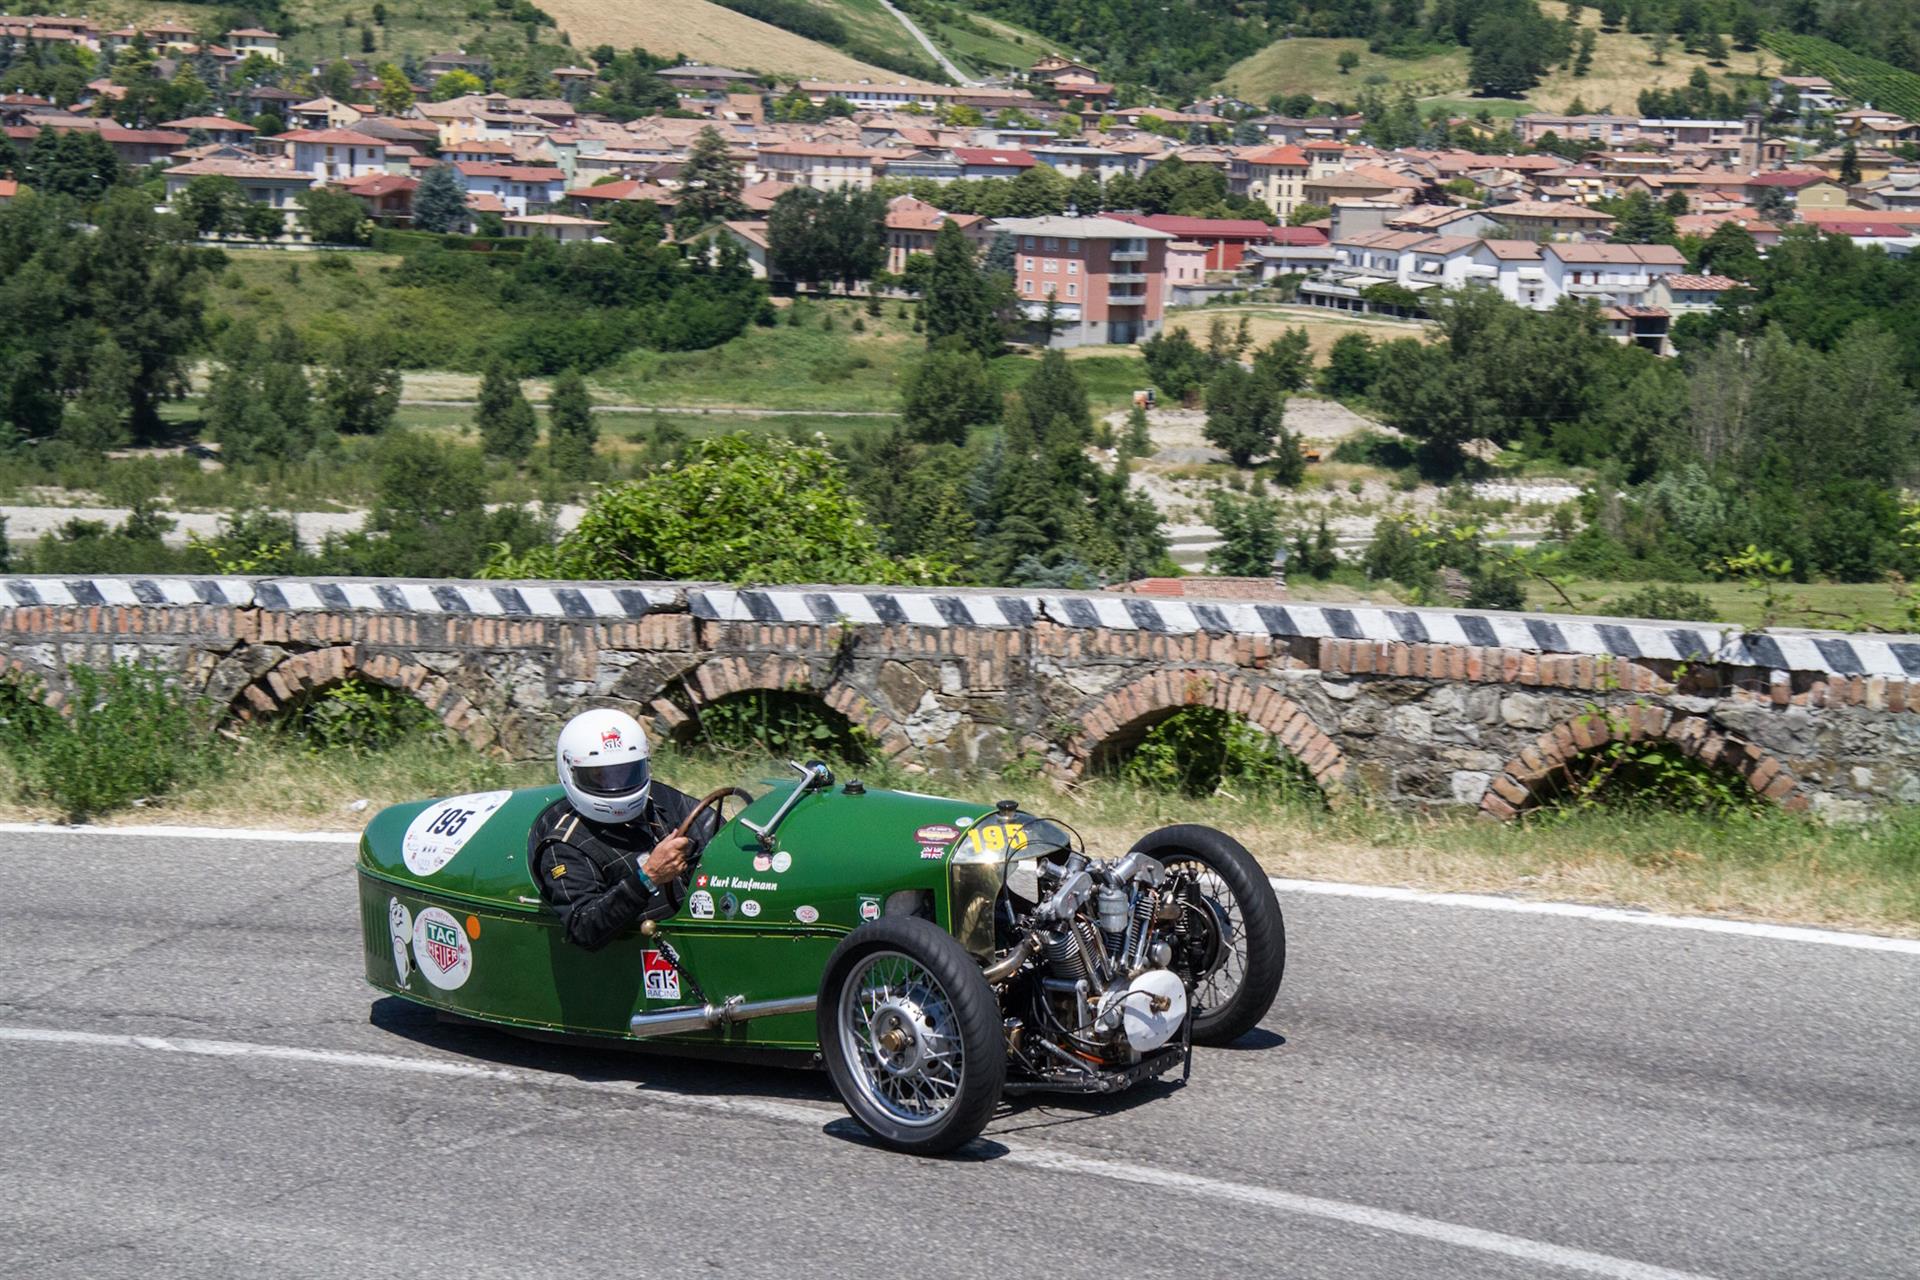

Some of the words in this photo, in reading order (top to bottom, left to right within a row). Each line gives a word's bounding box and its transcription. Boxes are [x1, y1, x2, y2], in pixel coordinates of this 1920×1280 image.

[425, 807, 476, 837] 195
[967, 823, 1029, 854] 195
[710, 875, 730, 888] Kurt
[731, 876, 778, 892] Kaufmann
[428, 924, 455, 946] TAG
[427, 941, 458, 969] HEUER
[647, 989, 680, 998] RACING
